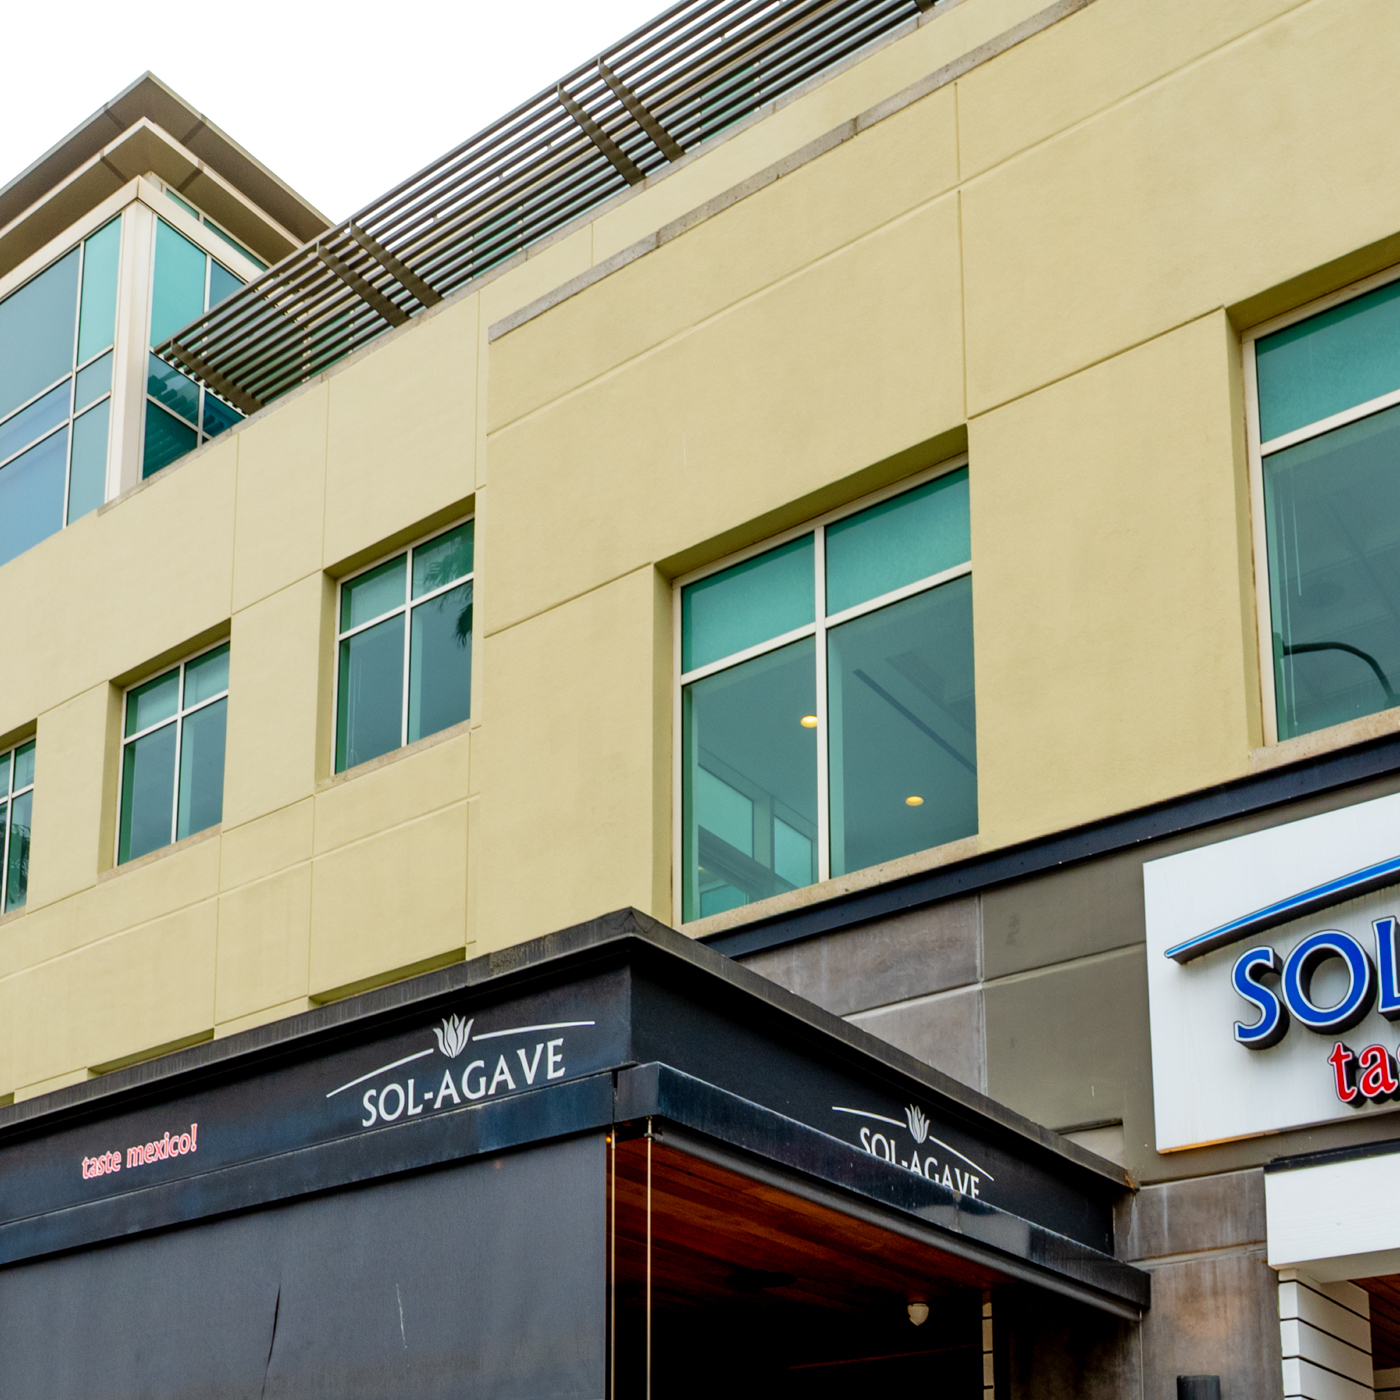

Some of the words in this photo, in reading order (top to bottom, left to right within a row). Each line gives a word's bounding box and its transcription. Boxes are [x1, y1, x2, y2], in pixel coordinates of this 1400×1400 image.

[362, 1037, 566, 1128] SOL-AGAVE
[82, 1151, 122, 1180] taste
[126, 1123, 198, 1169] mexico!
[860, 1126, 980, 1200] SOL-AGAVE
